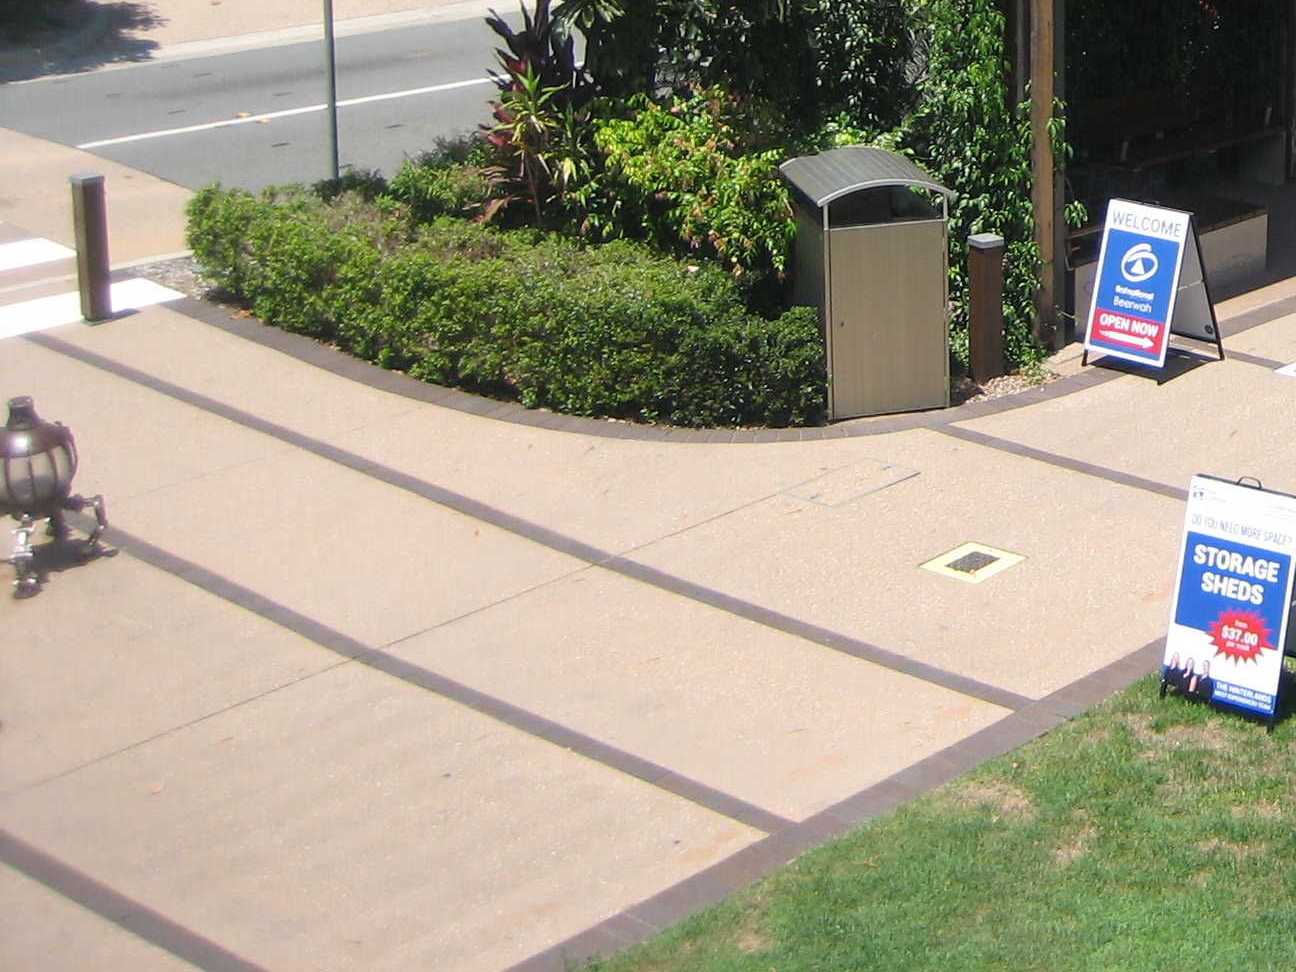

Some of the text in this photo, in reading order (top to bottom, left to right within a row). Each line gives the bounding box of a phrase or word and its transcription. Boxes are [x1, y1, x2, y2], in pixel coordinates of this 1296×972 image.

[1112, 211, 1184, 238] WELCOME
[1113, 295, 1152, 314] Beerwah
[1099, 313, 1159, 338] OPEN NOW
[1204, 515, 1218, 529] YOU
[1220, 519, 1240, 534] NEED
[1240, 525, 1263, 541] MORE
[1263, 530, 1293, 546] SPACE?
[1193, 543, 1281, 583] STORAGE
[1200, 571, 1265, 605] SHEDS
[1221, 625, 1259, 645] $37.00
